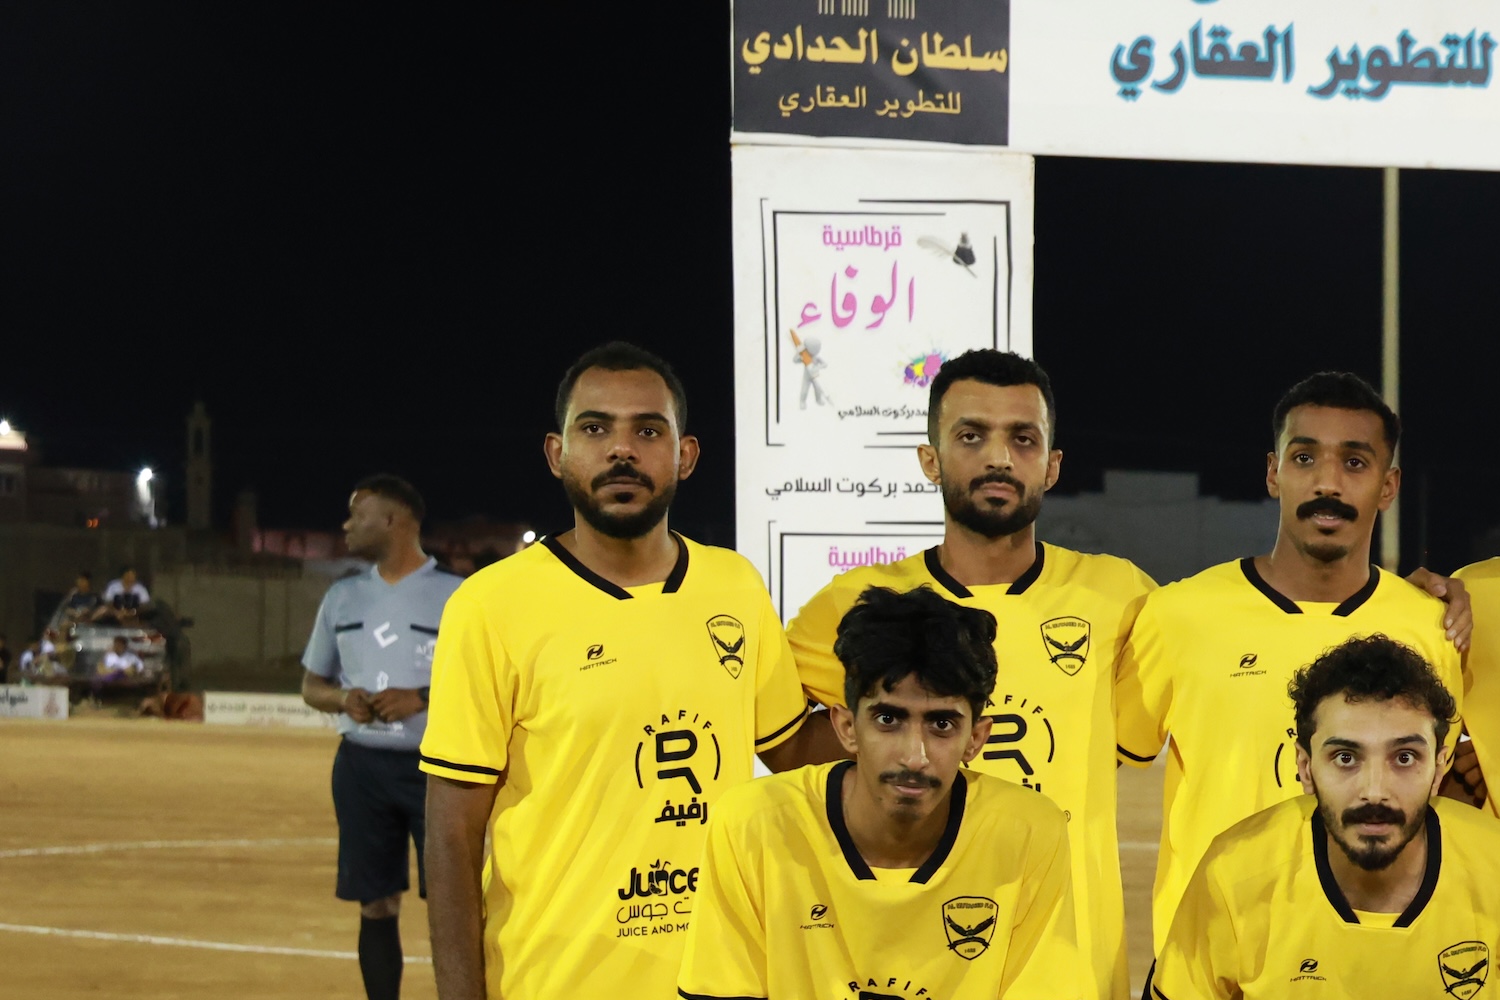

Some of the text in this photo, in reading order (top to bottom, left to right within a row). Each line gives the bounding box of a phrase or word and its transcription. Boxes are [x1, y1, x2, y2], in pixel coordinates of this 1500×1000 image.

[741, 26, 1008, 75] سلطان الحدادي
[1111, 18, 1295, 101] العقاري
[1306, 28, 1497, 101] للتطوير
[778, 85, 961, 117] للتطوير العقاري
[822, 225, 902, 251] قرطاسية
[796, 260, 915, 330] الوفاء
[765, 477, 831, 501] السلامي
[836, 477, 897, 498] بركوت
[984, 694, 1044, 715] AFIF
[643, 709, 713, 737] RAFIF
[616, 927, 648, 938] JUICE
[651, 923, 674, 935] AND
[847, 977, 928, 997] RAFIF
